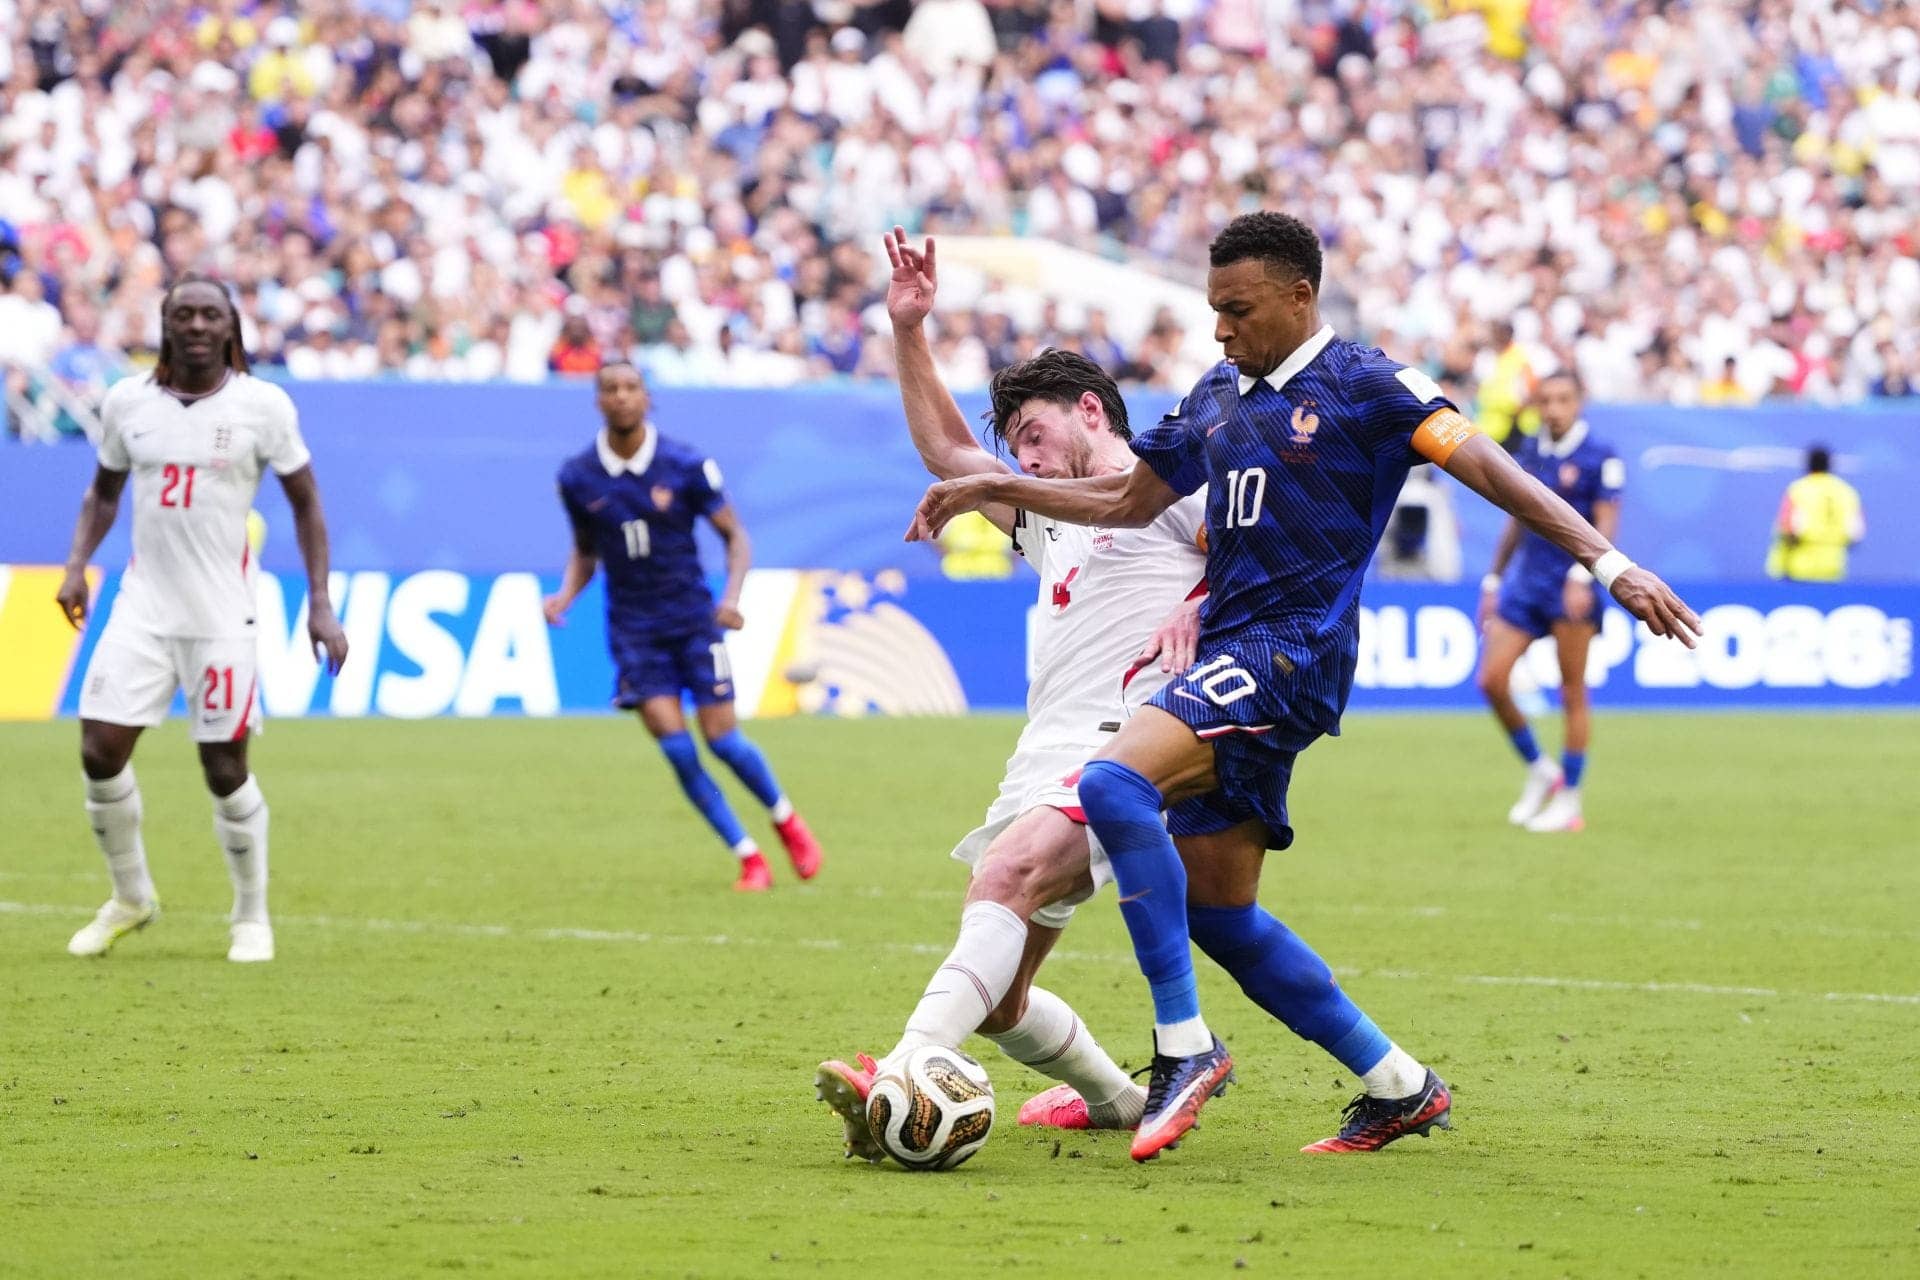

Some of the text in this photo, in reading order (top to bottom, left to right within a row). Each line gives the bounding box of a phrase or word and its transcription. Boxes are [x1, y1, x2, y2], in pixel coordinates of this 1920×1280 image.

[160, 463, 195, 508] 21
[1226, 467, 1266, 529] 10
[621, 519, 650, 559] 11
[1052, 566, 1079, 611] 4
[254, 570, 560, 719] VISA
[1634, 603, 1889, 689] 2026
[203, 665, 234, 710] 21
[1186, 654, 1257, 706] 10
